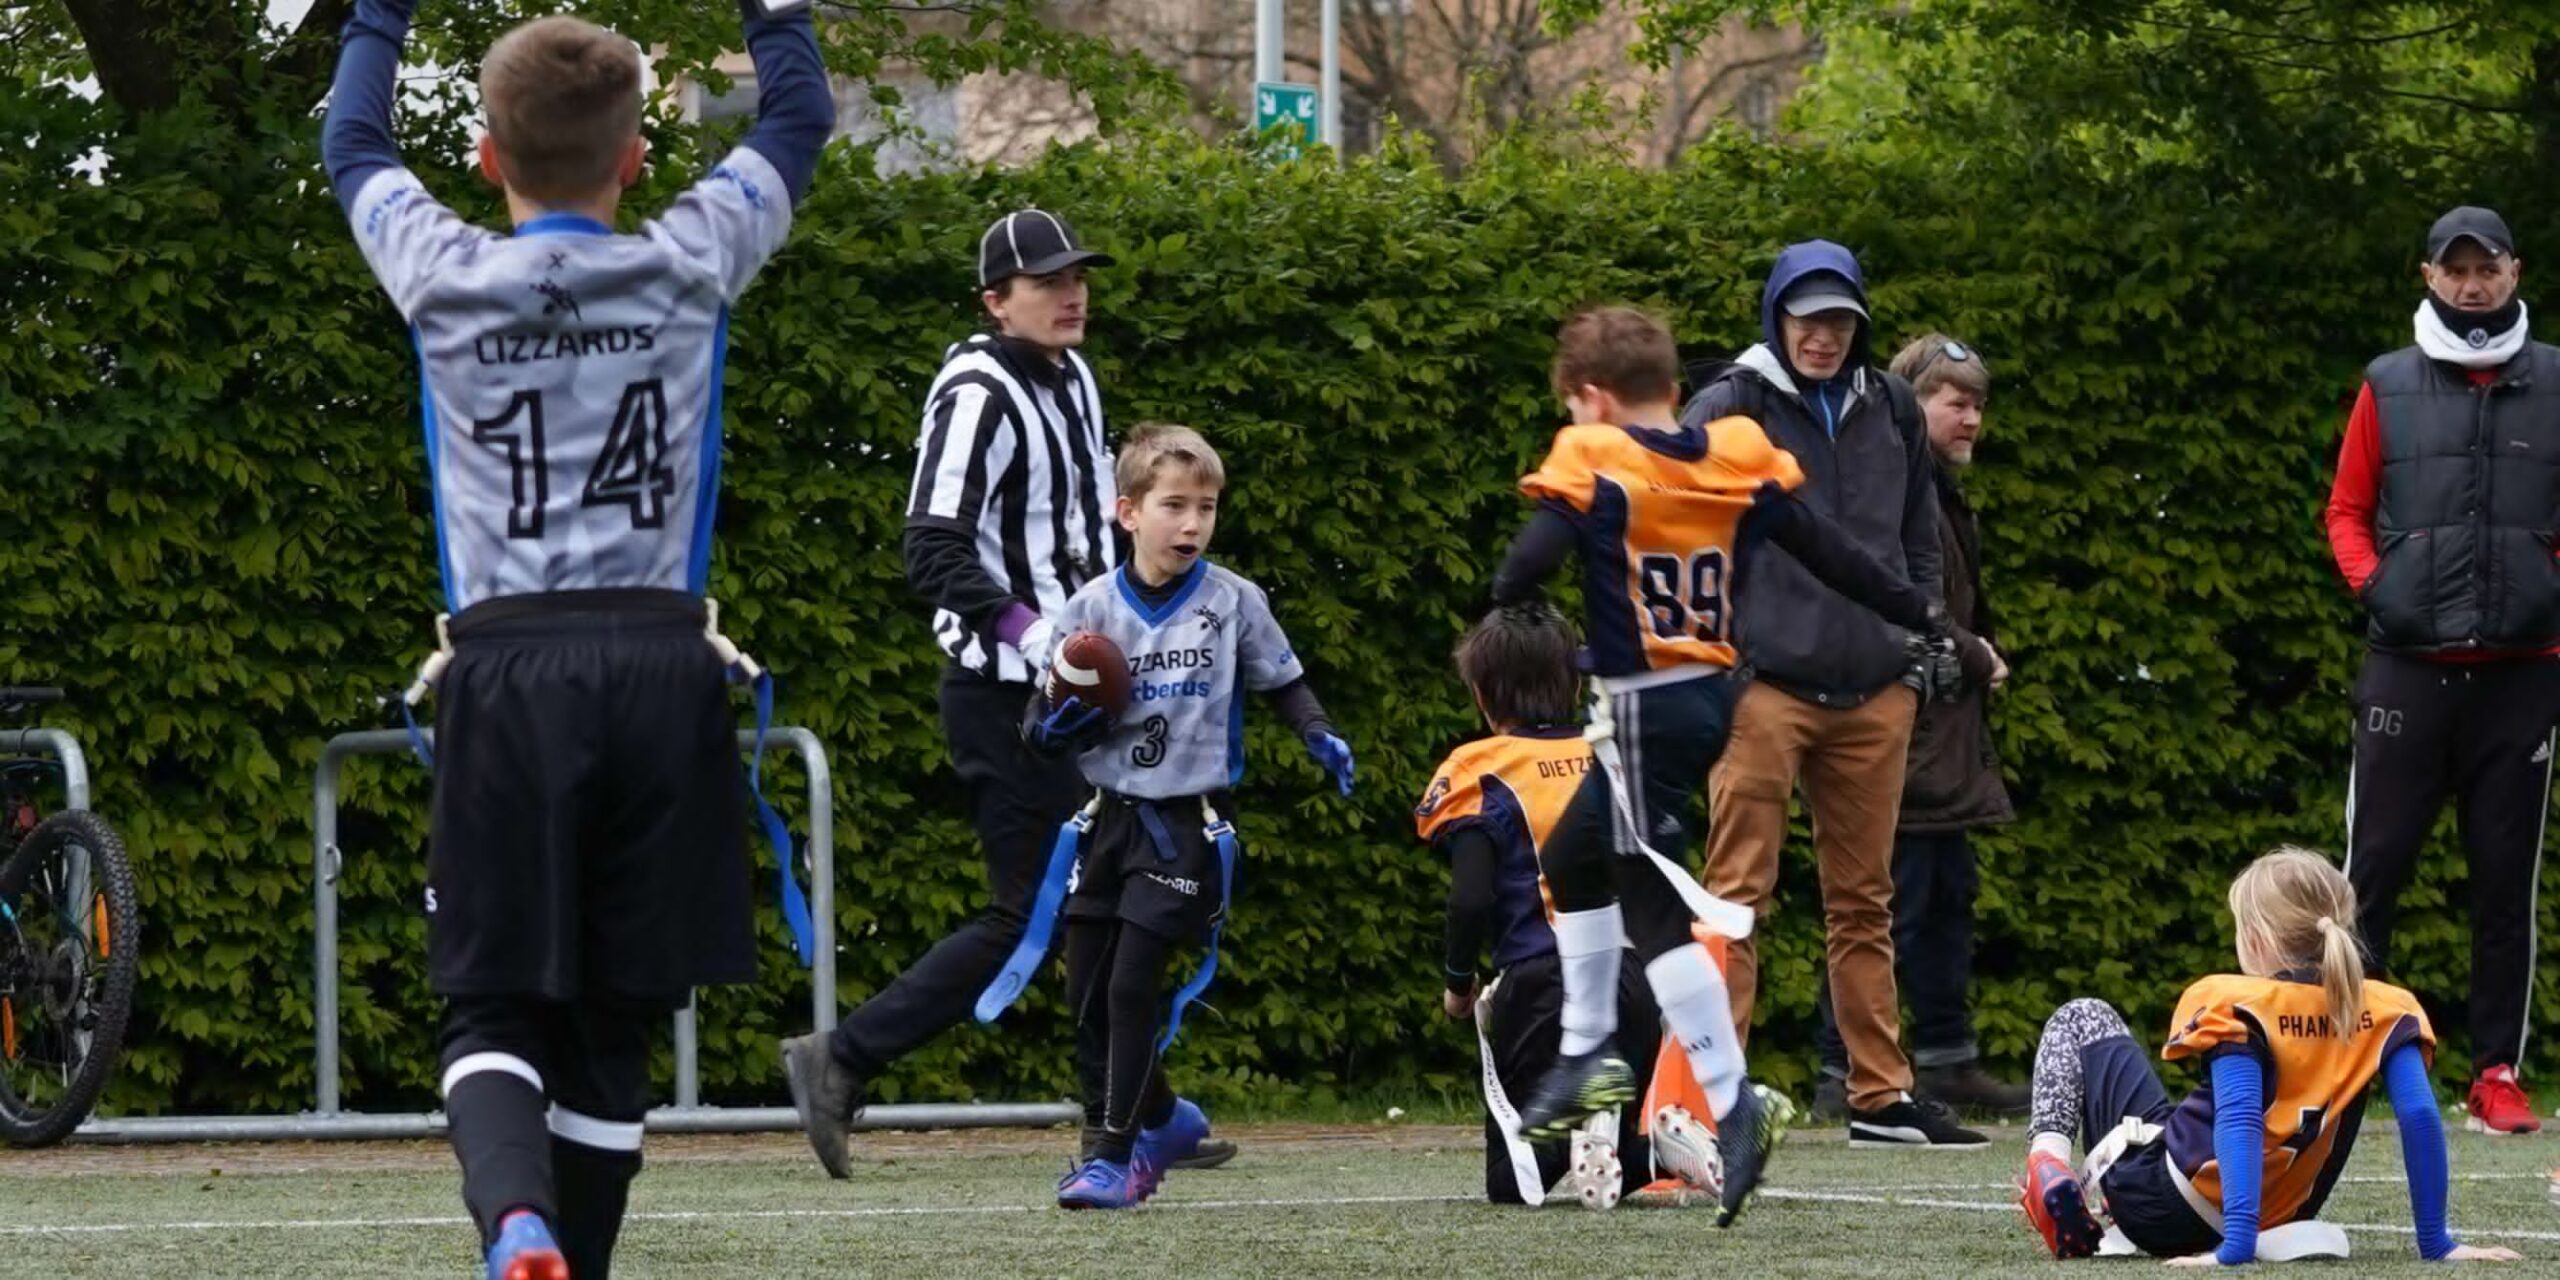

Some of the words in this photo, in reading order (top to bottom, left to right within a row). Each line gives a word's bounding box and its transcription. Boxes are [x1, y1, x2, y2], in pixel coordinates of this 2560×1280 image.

[476, 323, 656, 365] LIZZARDS
[473, 377, 676, 539] 14
[1639, 545, 1731, 643] 89
[1131, 712, 1169, 769] 3
[2368, 705, 2404, 736] DG
[2278, 1010, 2375, 1039] PHANS
